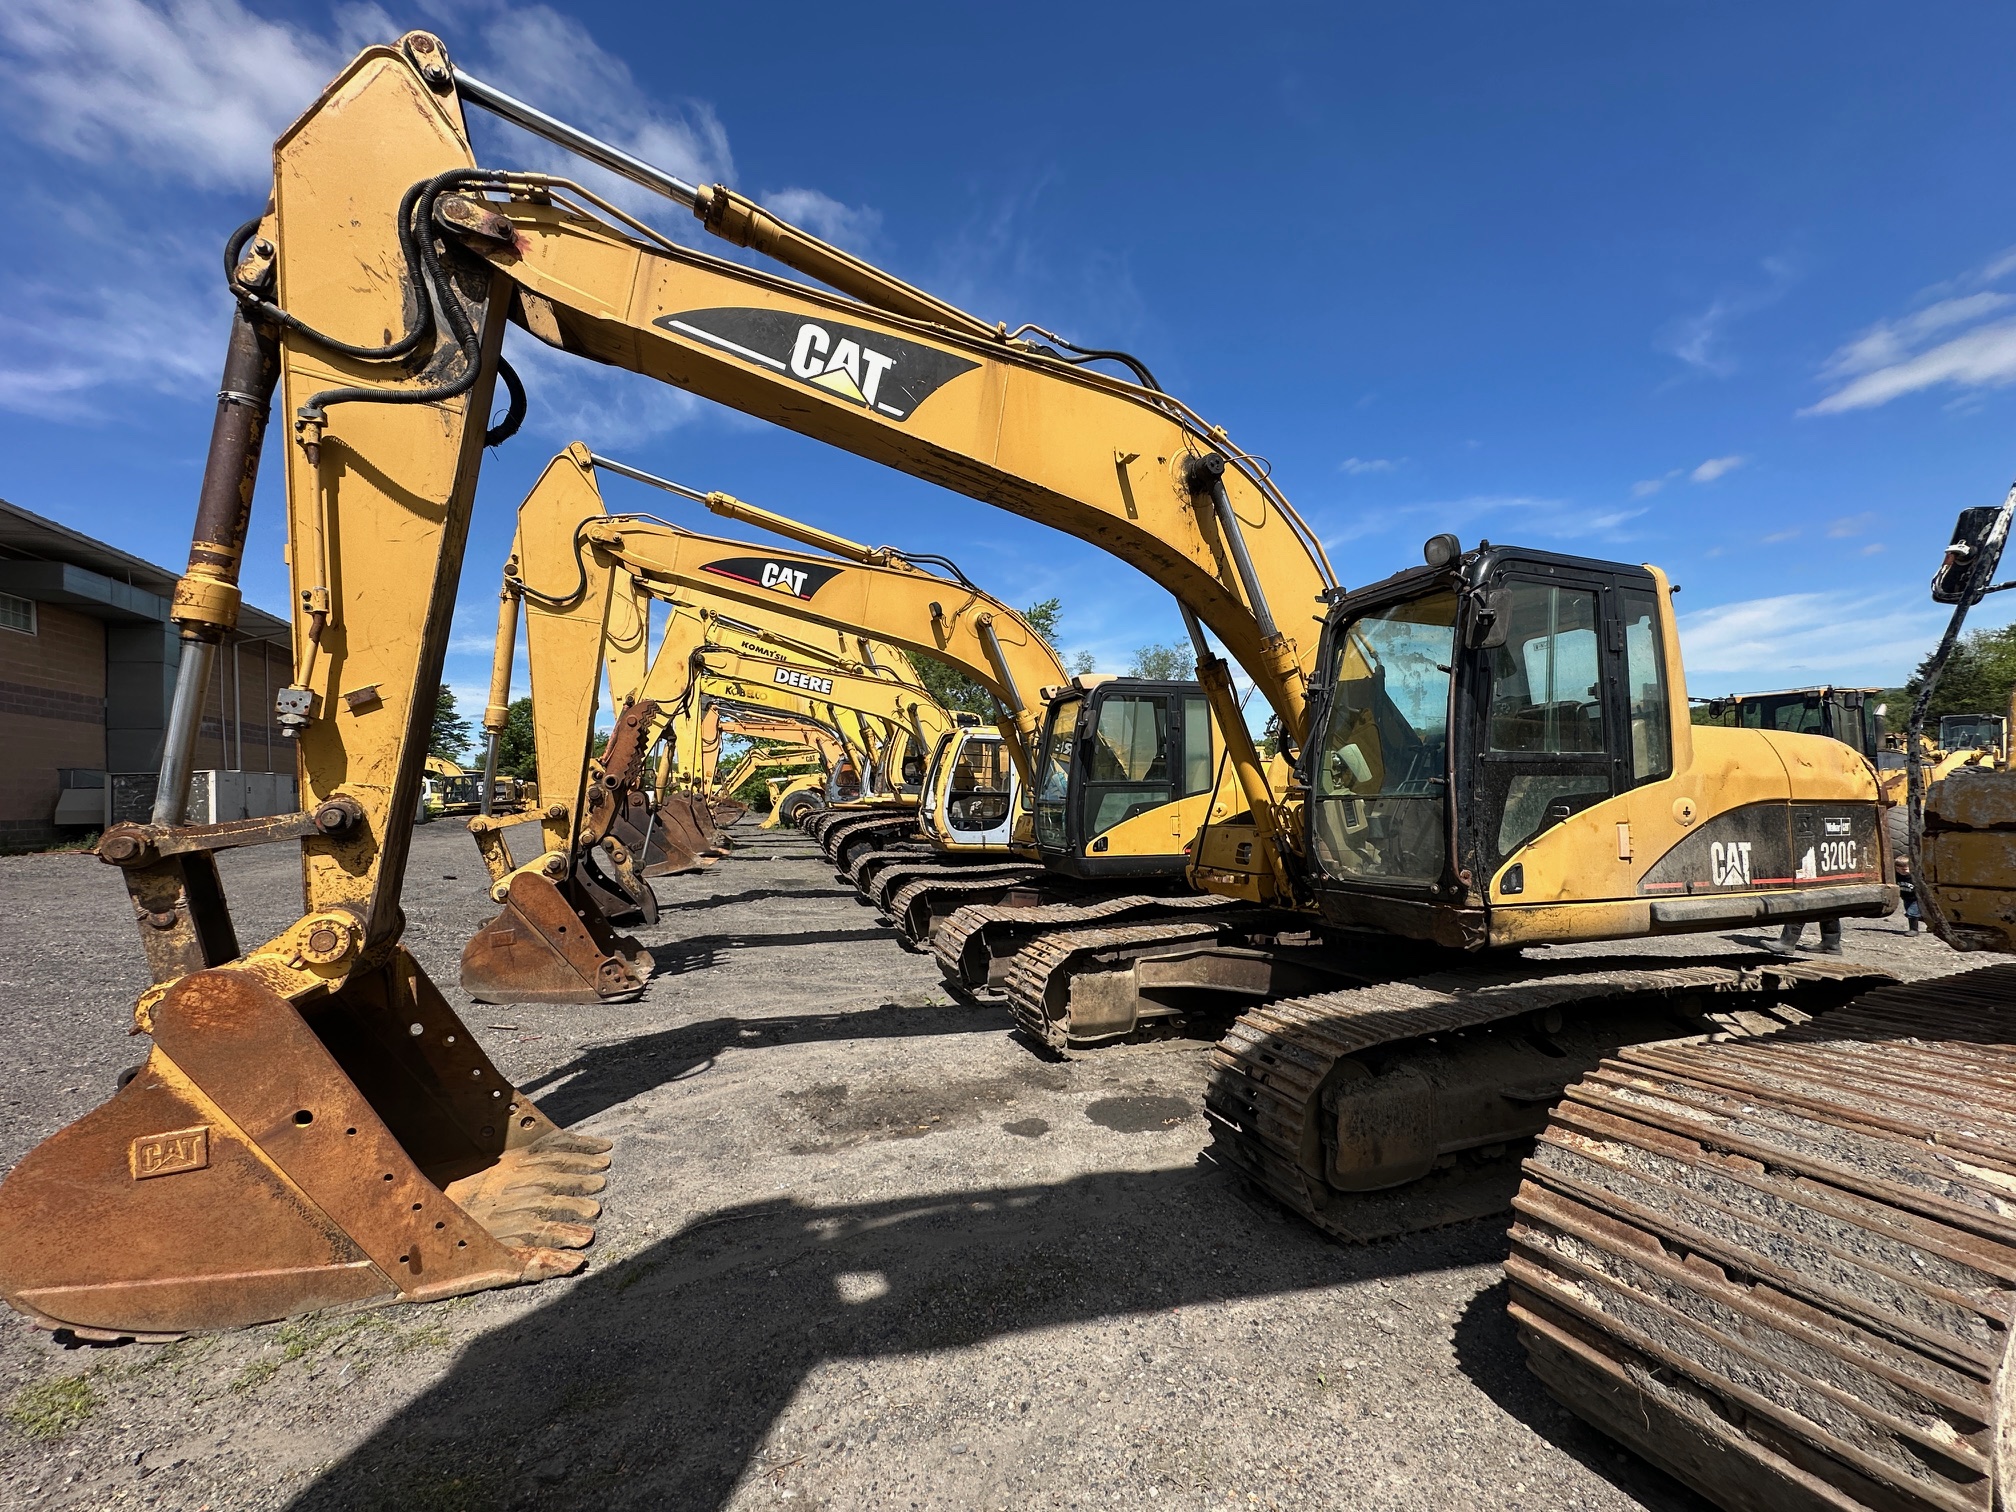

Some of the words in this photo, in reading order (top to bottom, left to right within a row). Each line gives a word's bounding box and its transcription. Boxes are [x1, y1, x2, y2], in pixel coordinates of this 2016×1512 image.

[790, 323, 896, 405] CAT
[761, 562, 808, 597] CAT
[741, 641, 787, 661] KOMATSU
[774, 667, 833, 695] DEERE
[1711, 841, 1751, 886] CAT
[1820, 840, 1857, 871] 320C
[141, 1136, 201, 1173] CAT
